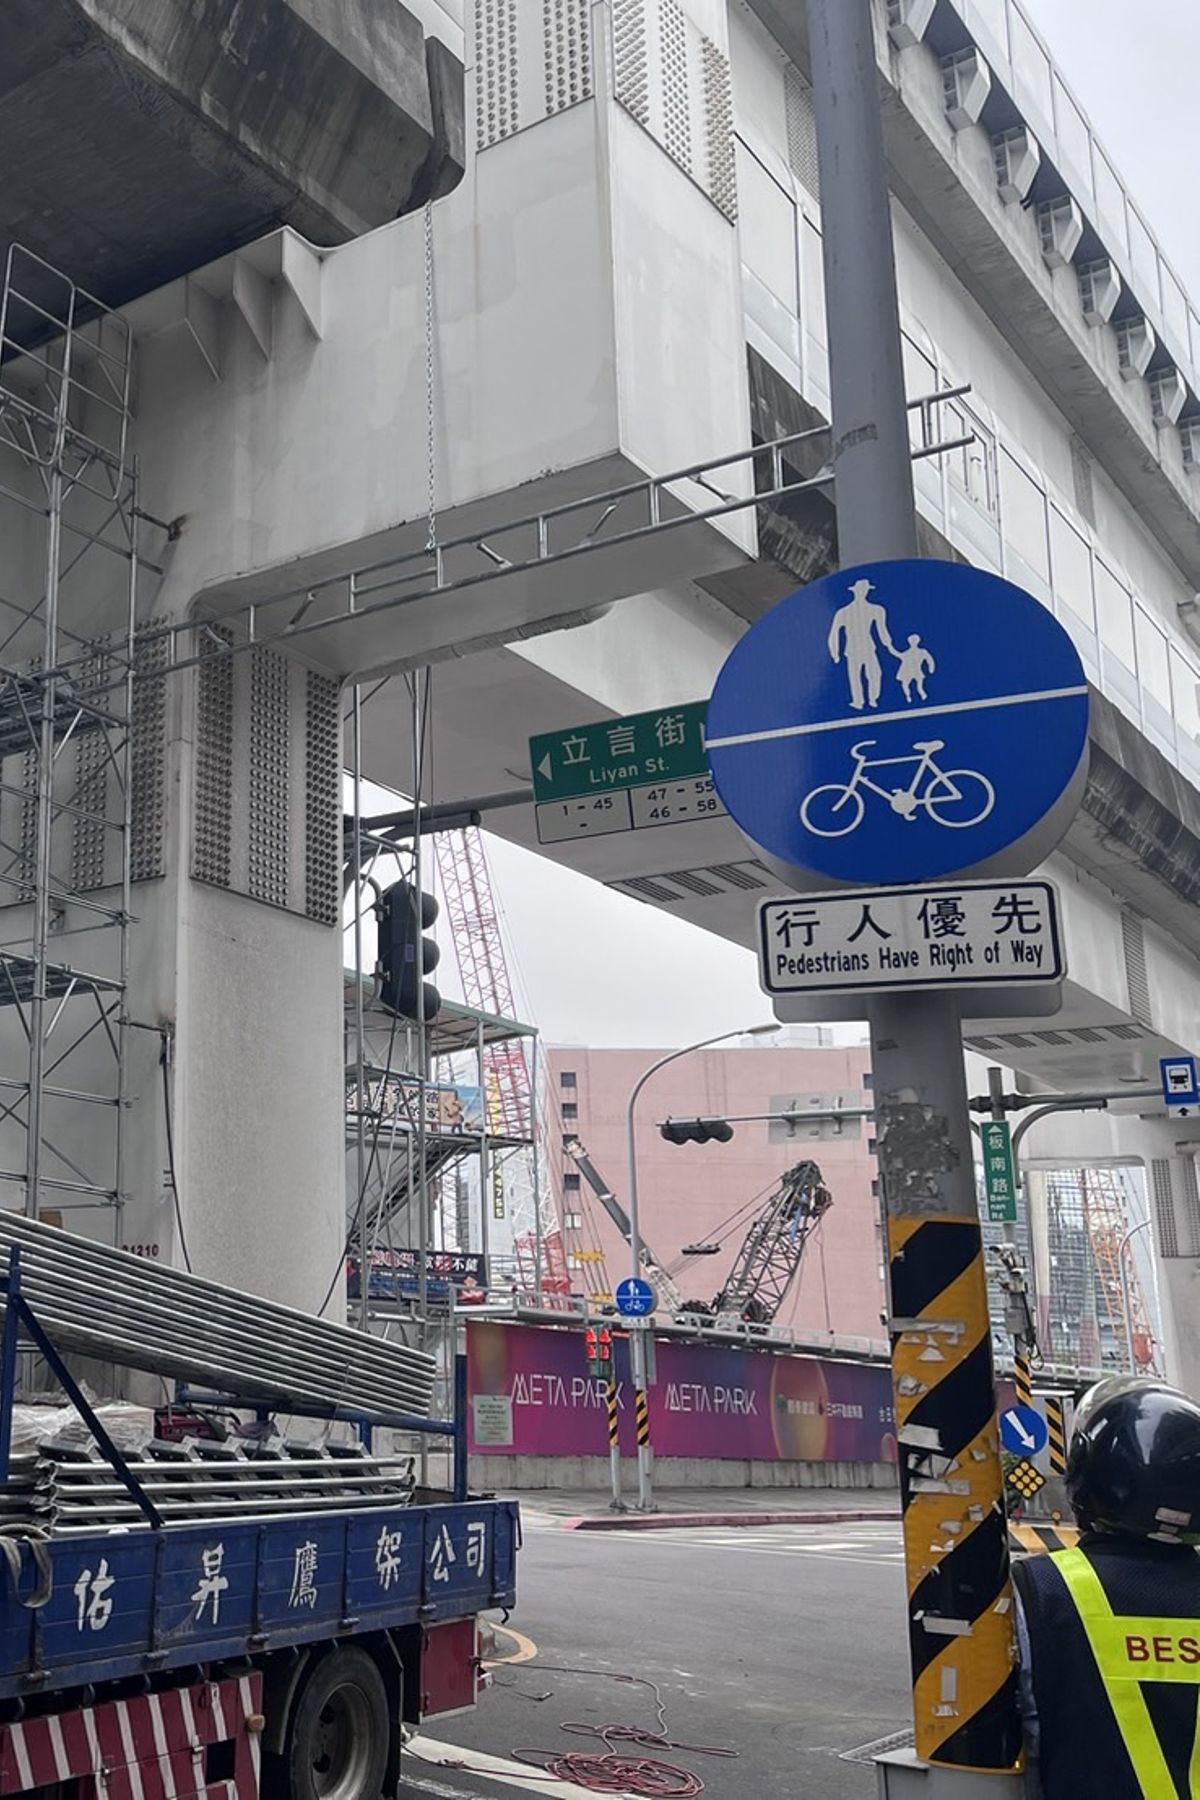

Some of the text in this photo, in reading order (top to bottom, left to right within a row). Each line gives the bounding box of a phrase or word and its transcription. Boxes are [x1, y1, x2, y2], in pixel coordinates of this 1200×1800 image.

[562, 714, 686, 766] 立言街
[589, 757, 670, 784] Liyan St.
[593, 797, 614, 811] 45
[647, 788, 667, 802] 47
[695, 781, 715, 794] 55
[649, 807, 671, 820] 46
[697, 799, 718, 813] 58
[775, 893, 1043, 948] 行人優先
[776, 939, 1044, 976] Pedestrians Have Right of Way
[989, 1134, 1008, 1193] 板南路
[73, 1521, 487, 1632] 佑昇鷹架公司
[1125, 1635, 1200, 1665] BES
